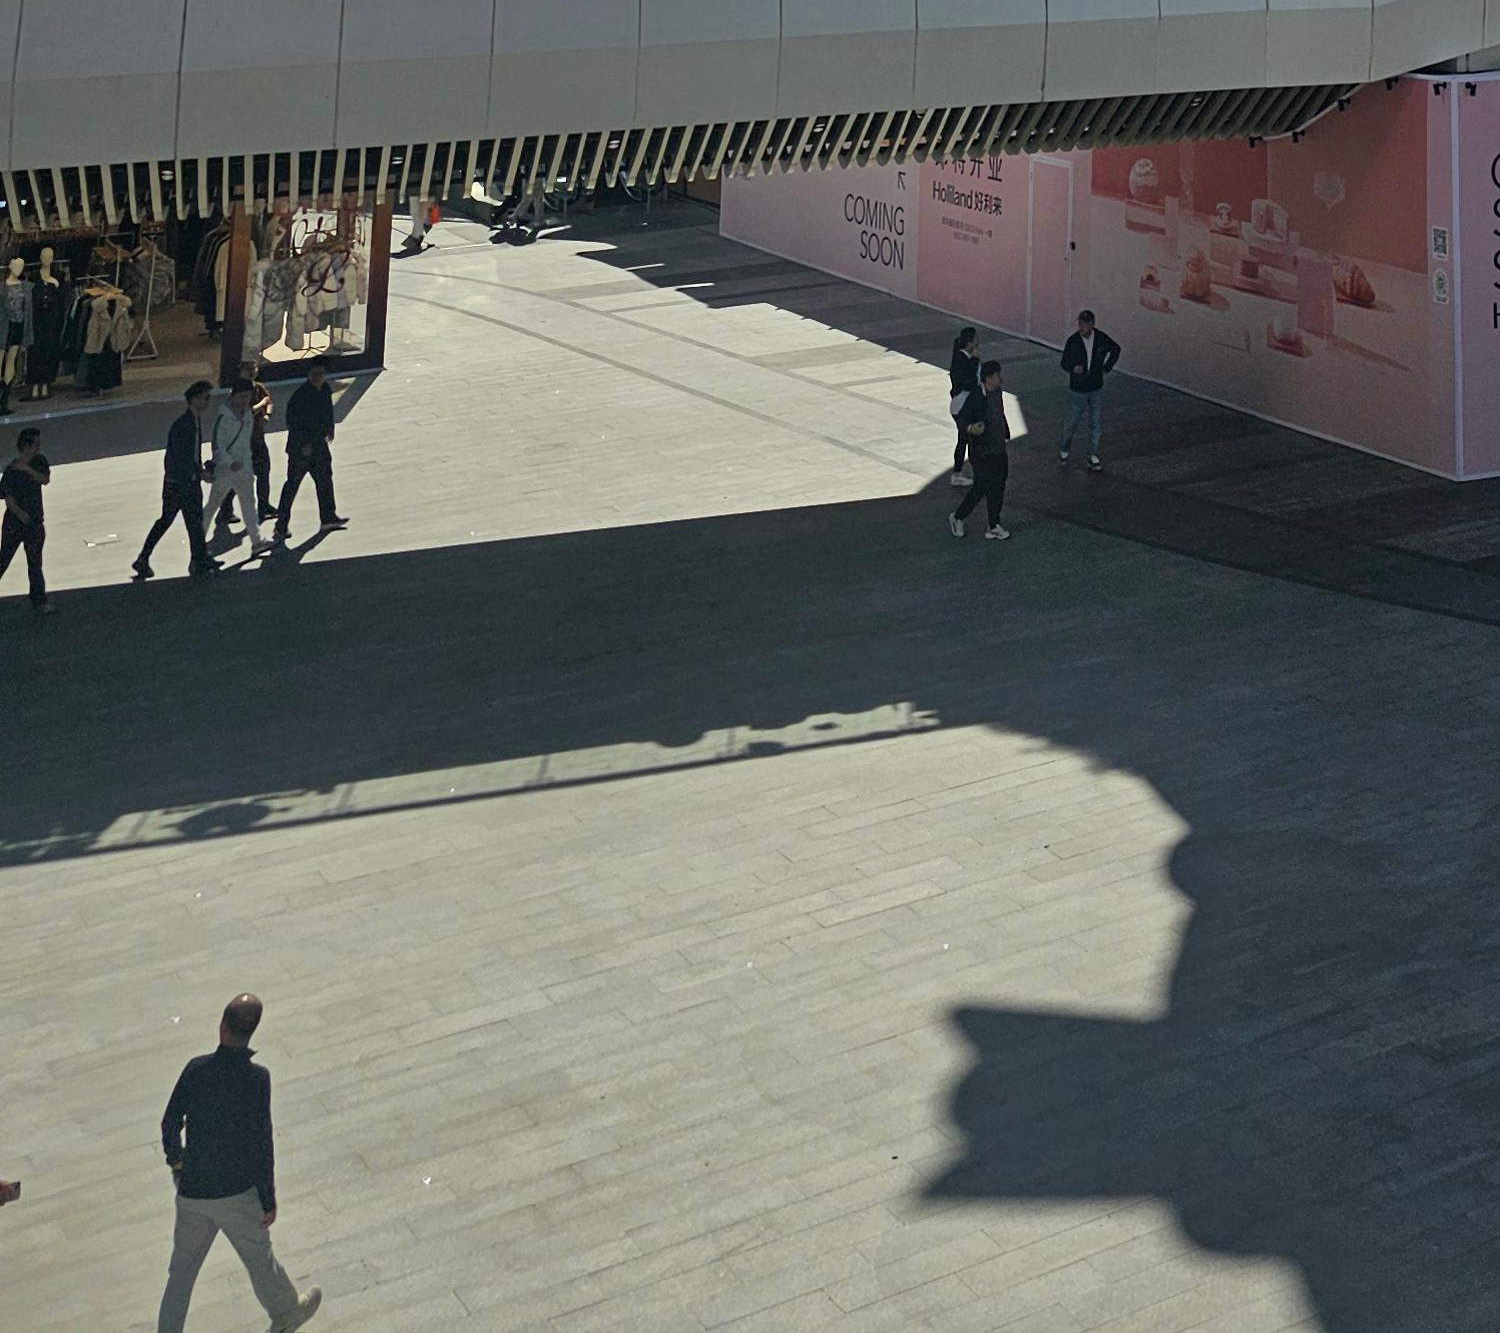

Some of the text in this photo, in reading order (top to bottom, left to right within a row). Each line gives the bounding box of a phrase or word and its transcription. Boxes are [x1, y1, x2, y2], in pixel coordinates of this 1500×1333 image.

[844, 193, 905, 236] COMING
[932, 180, 1003, 217] Holiland 好利来
[860, 230, 904, 270] SOON
